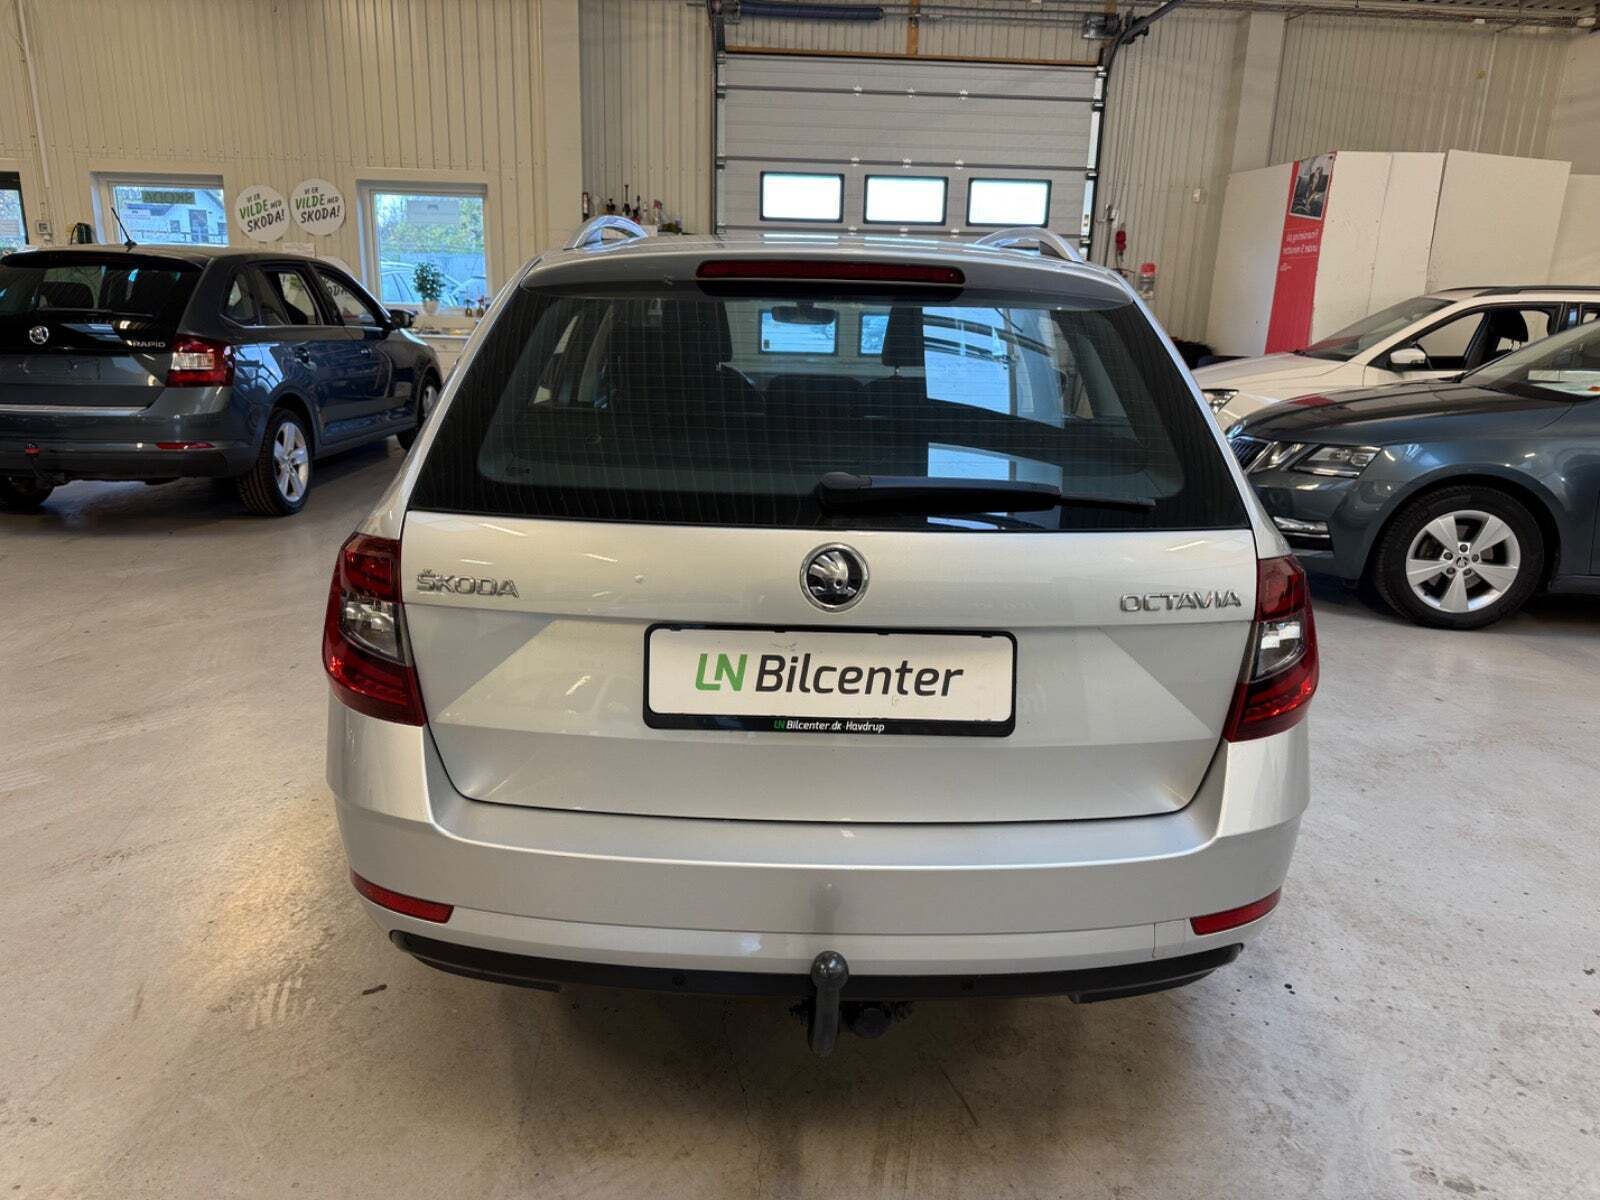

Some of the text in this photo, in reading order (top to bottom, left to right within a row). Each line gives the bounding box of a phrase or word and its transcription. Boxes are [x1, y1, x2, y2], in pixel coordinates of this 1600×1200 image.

[239, 200, 269, 220] VILDE
[295, 193, 326, 210] VILDE
[247, 208, 285, 233] SKODA!
[300, 205, 341, 223] SKODA!
[132, 340, 166, 348] RAPID
[1119, 590, 1242, 612] OCTAVIA
[695, 652, 964, 697] LN Bilcenter
[845, 721, 886, 733] Havdrup
